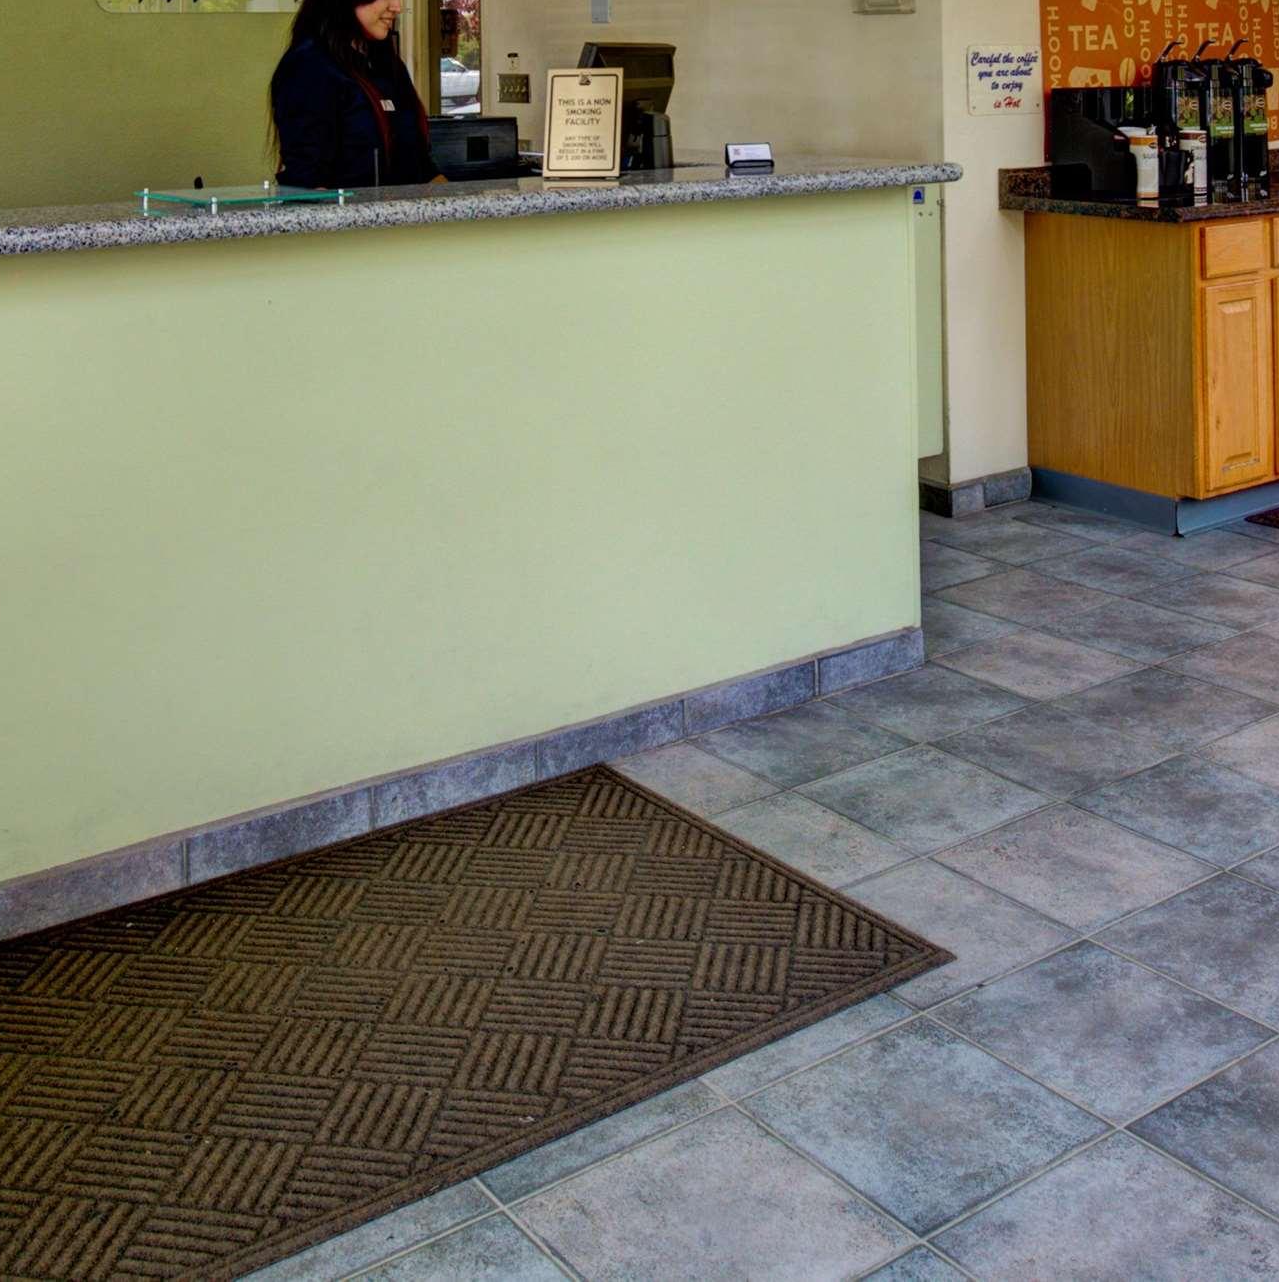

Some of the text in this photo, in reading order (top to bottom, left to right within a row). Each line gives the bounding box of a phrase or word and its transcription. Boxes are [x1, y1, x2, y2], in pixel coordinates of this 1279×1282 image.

[1068, 25, 1118, 51] TEA
[1194, 22, 1234, 47] TEA
[971, 51, 1038, 67] Careful the coffee
[978, 65, 1033, 81] you are about
[991, 80, 1023, 92] to enjoy
[558, 98, 575, 106] THIS
[594, 98, 611, 106] NON
[566, 108, 602, 116] SMOKING
[565, 118, 600, 126] FACILITY
